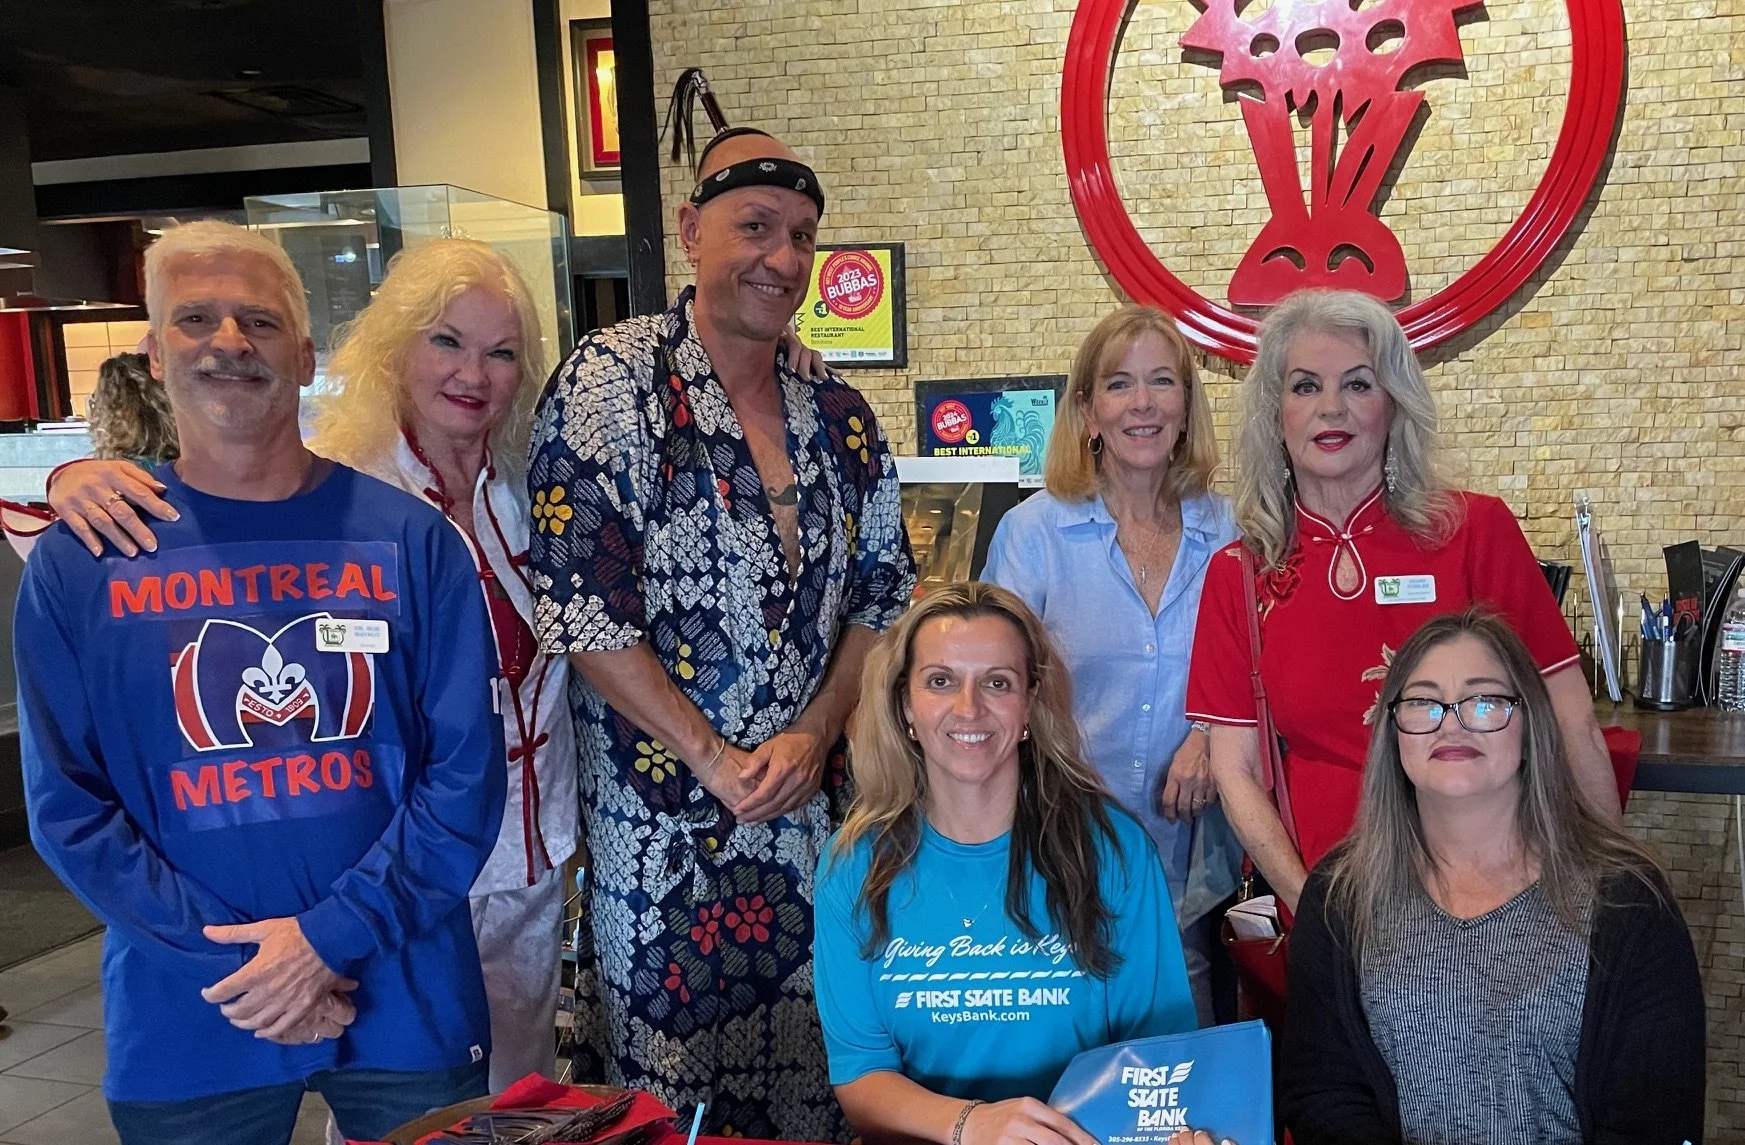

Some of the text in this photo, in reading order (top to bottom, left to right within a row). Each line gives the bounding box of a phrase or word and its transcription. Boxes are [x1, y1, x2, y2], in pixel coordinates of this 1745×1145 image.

[837, 268, 862, 283] 2023
[827, 274, 878, 300] BUBBAS
[937, 414, 967, 430] BUBBAS
[934, 446, 1032, 456] BEST INTERNATIONAL
[110, 562, 397, 618] MONTREAL
[170, 750, 373, 811] METROS
[884, 937, 946, 968] Giving
[950, 936, 1008, 958] Back
[1010, 937, 1033, 956] is
[916, 988, 1070, 1008] FIRST STATE BANK
[932, 1010, 1030, 1024] KeysBank.com
[1121, 1066, 1169, 1086] FIRST
[1128, 1087, 1178, 1108] STATE
[1138, 1107, 1188, 1127] BANK
